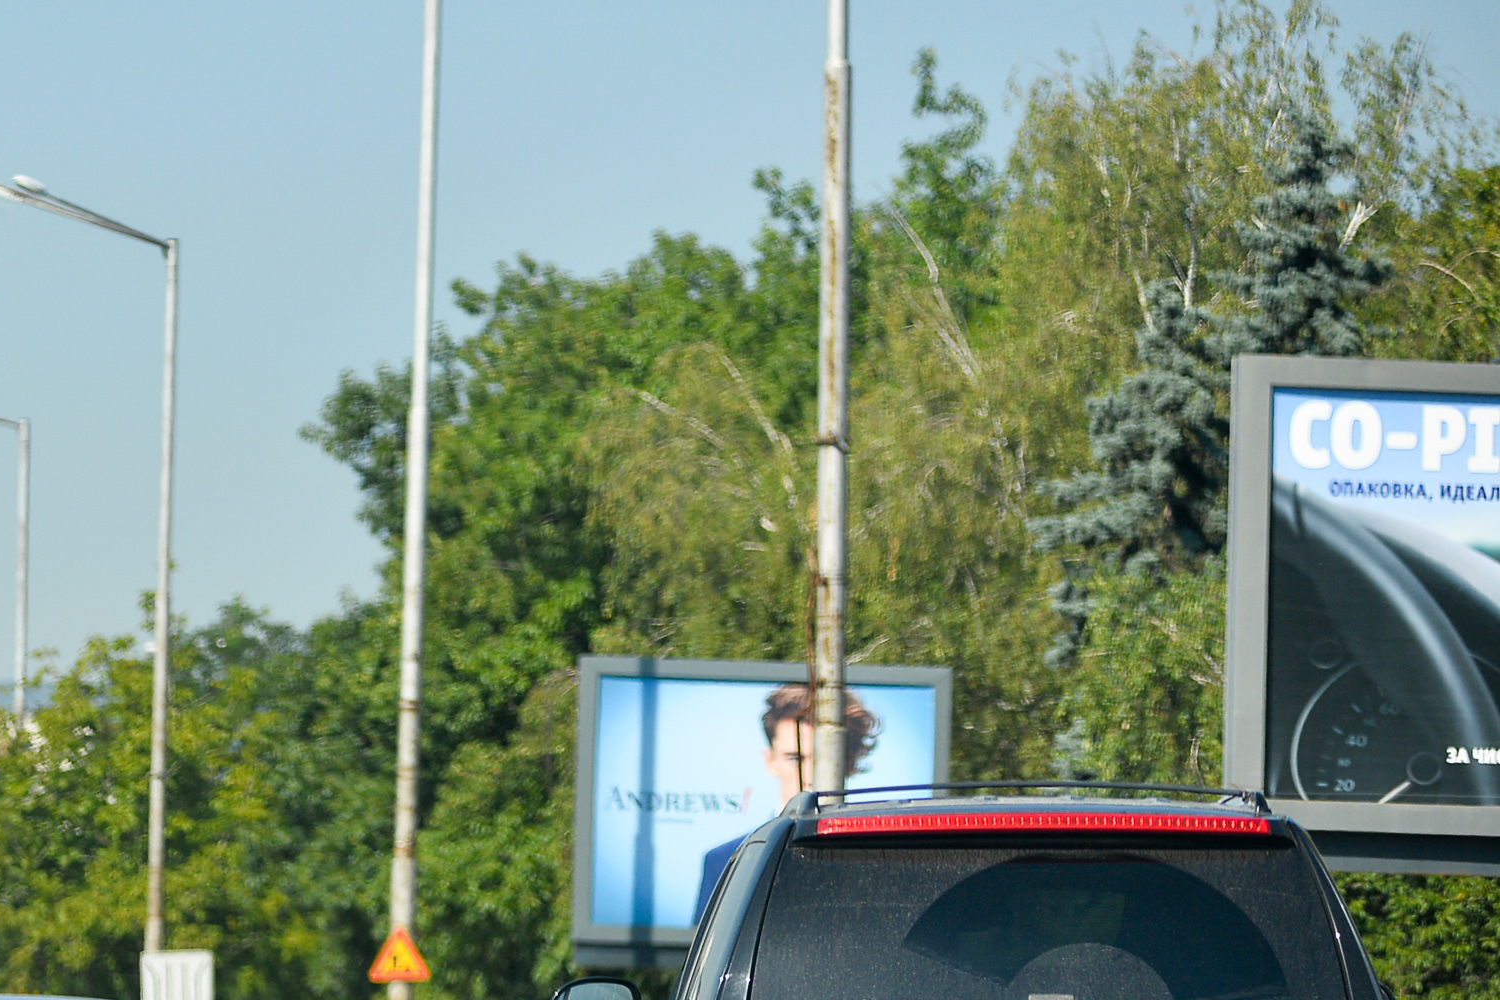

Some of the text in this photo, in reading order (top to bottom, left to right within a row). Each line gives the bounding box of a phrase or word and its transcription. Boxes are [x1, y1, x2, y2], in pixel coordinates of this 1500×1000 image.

[1289, 400, 1500, 474] CO-PI
[1330, 480, 1433, 502] ОПАКОВКА,
[1345, 734, 1368, 747] 40
[1445, 746, 1471, 764] ЗА
[1334, 778, 1356, 792] 20
